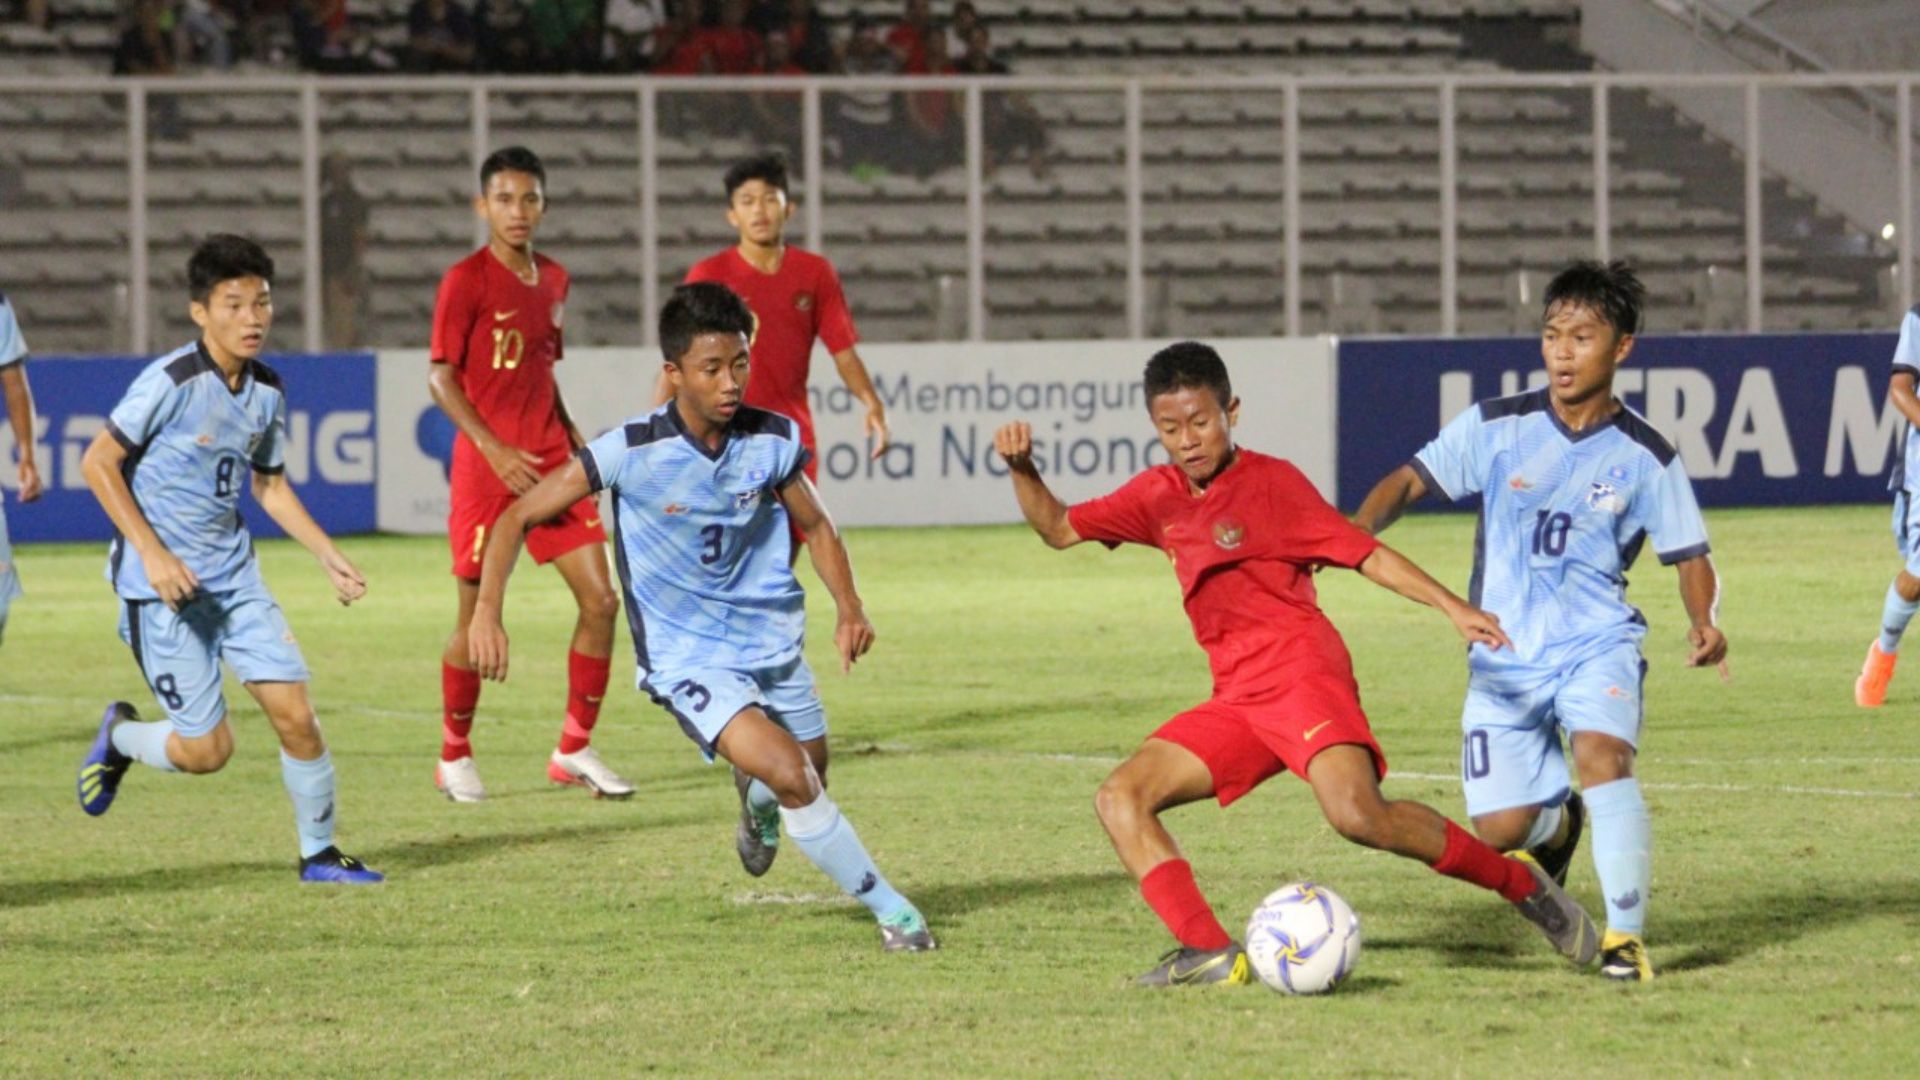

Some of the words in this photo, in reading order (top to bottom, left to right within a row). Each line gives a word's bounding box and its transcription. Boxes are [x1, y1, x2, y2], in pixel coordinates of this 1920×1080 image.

[492, 328, 524, 370] 10
[215, 455, 235, 498] 8
[700, 523, 724, 565] 3
[1532, 509, 1572, 557] 10
[155, 672, 184, 711] 8
[671, 678, 711, 713] 3
